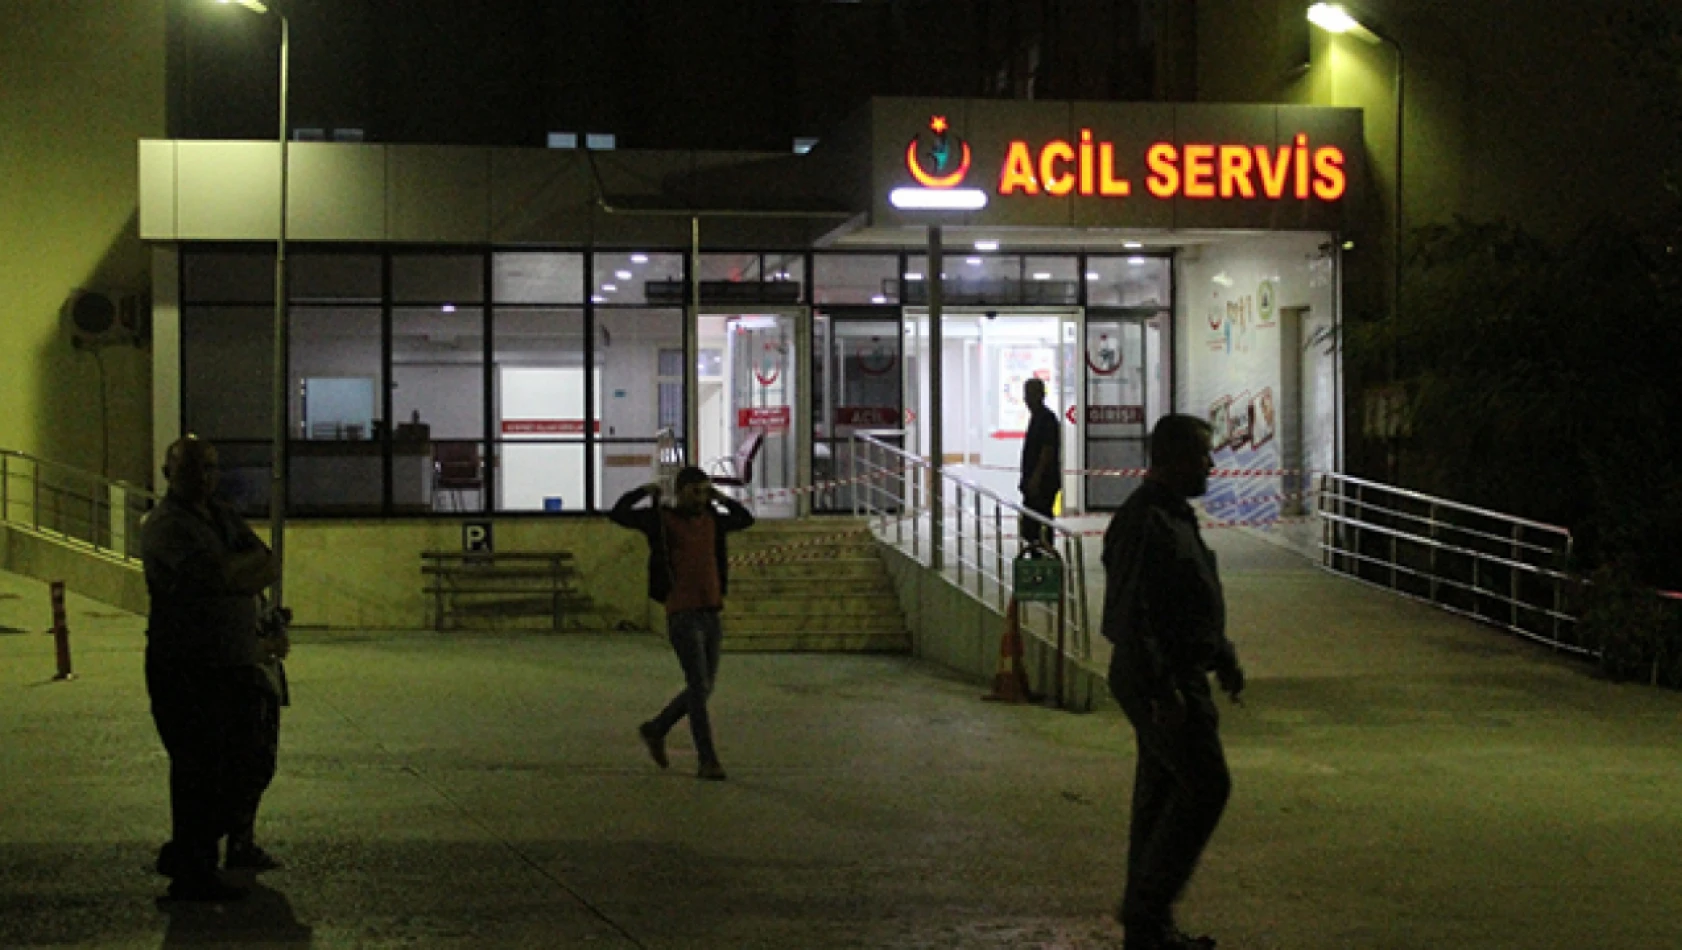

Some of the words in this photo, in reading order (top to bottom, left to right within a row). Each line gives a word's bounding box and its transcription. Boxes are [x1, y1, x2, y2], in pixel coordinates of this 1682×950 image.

[999, 128, 1131, 196] ACİL
[1146, 133, 1347, 200] SERVİS
[466, 525, 485, 550] P
